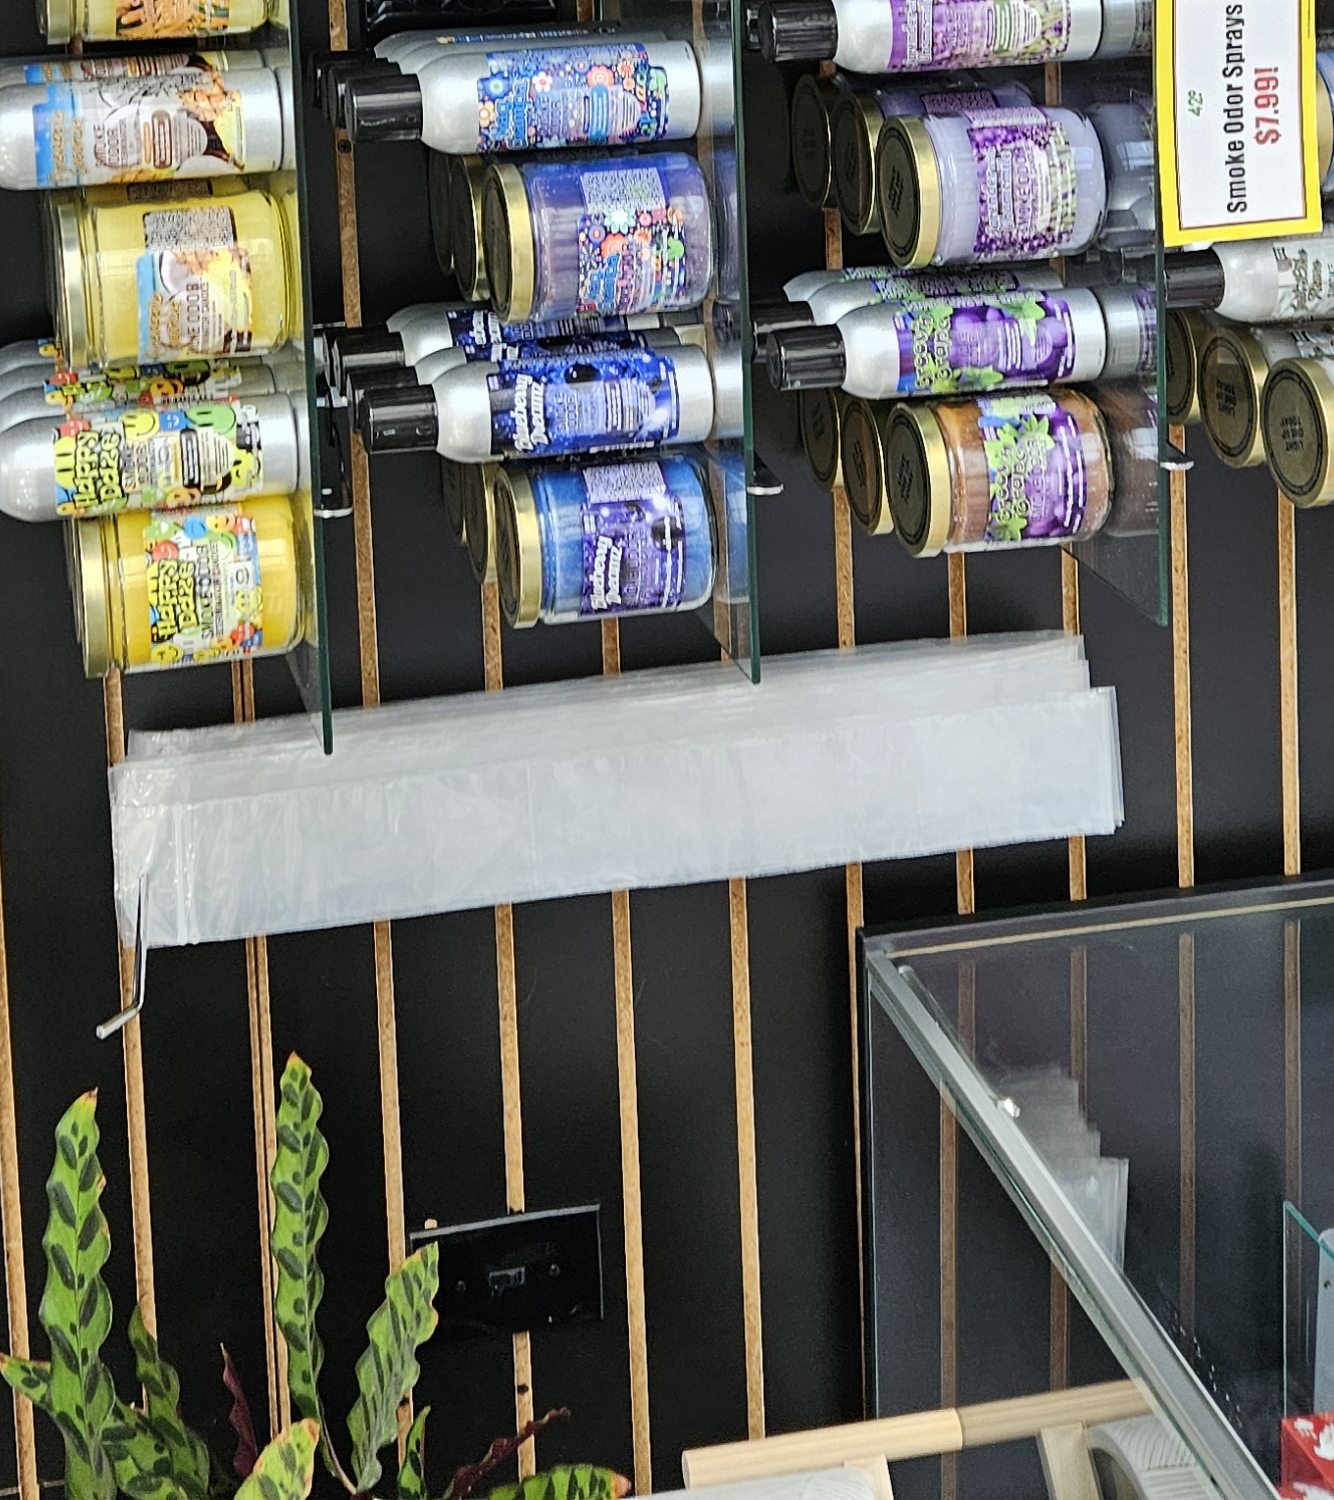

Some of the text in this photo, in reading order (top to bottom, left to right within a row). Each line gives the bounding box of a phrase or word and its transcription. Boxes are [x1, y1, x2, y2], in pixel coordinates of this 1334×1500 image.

[1222, 4, 1247, 213] Smoke Odor Sprays
[1254, 67, 1281, 145] $7.99!
